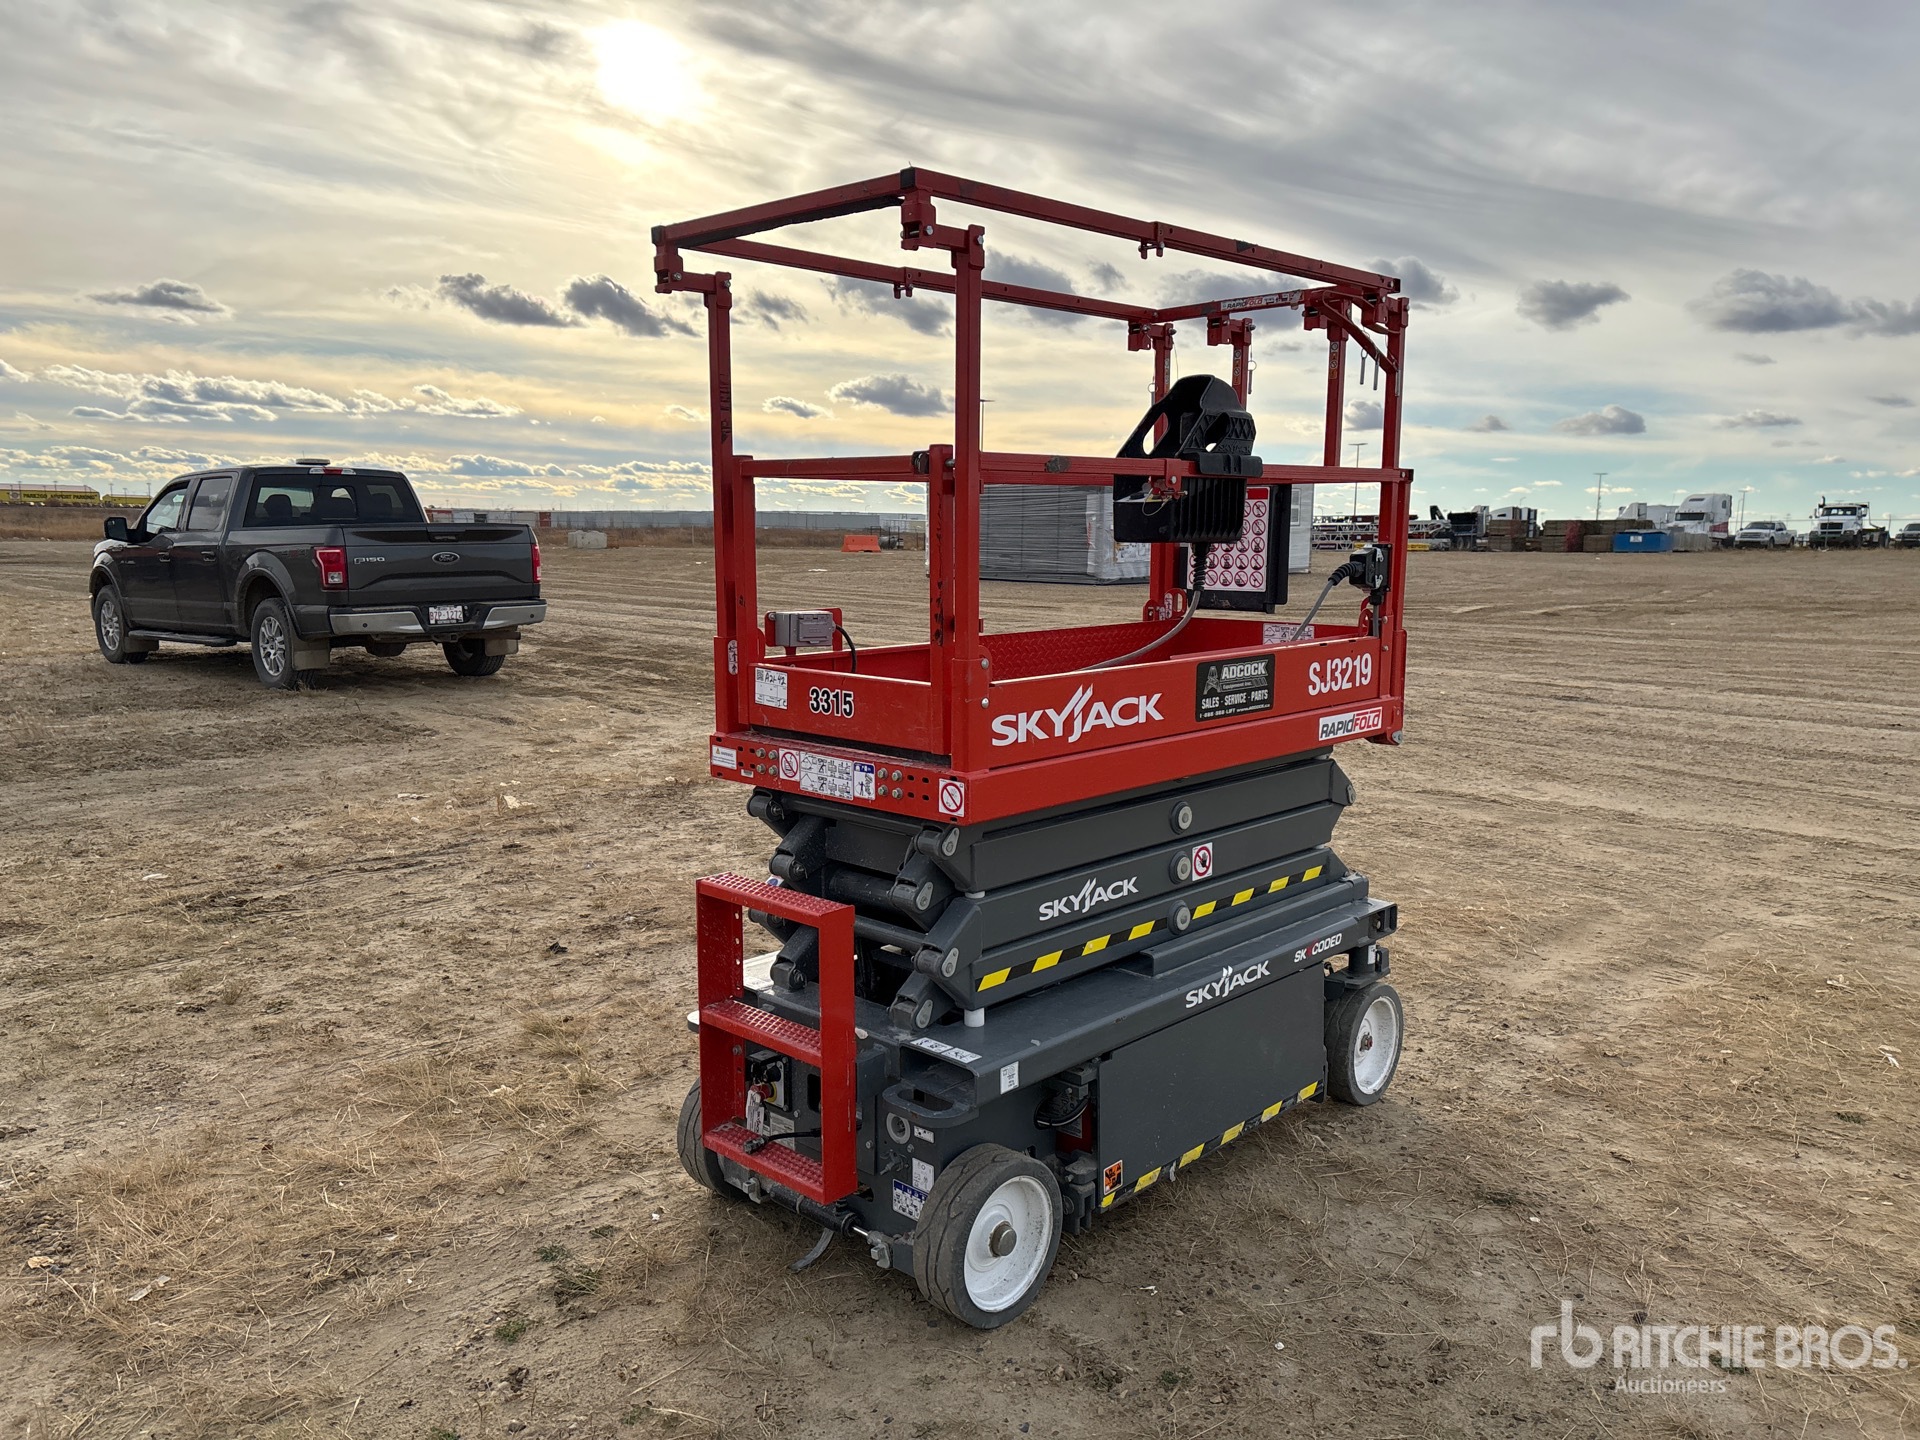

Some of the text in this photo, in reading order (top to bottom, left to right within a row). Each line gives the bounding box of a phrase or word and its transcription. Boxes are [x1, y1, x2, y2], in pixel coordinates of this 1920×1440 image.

[1221, 662, 1266, 680] ADCOCK
[1222, 682, 1245, 690] Equipment
[1308, 653, 1372, 697] SJ3219
[809, 686, 854, 718] 3315
[991, 684, 1165, 747] SKYJACK
[1202, 696, 1219, 709] SALES
[1224, 692, 1247, 705] SERVICE
[1251, 689, 1268, 701] PARTS
[1038, 876, 1139, 922] SKYJACK
[1185, 960, 1270, 1009] SKYJACK
